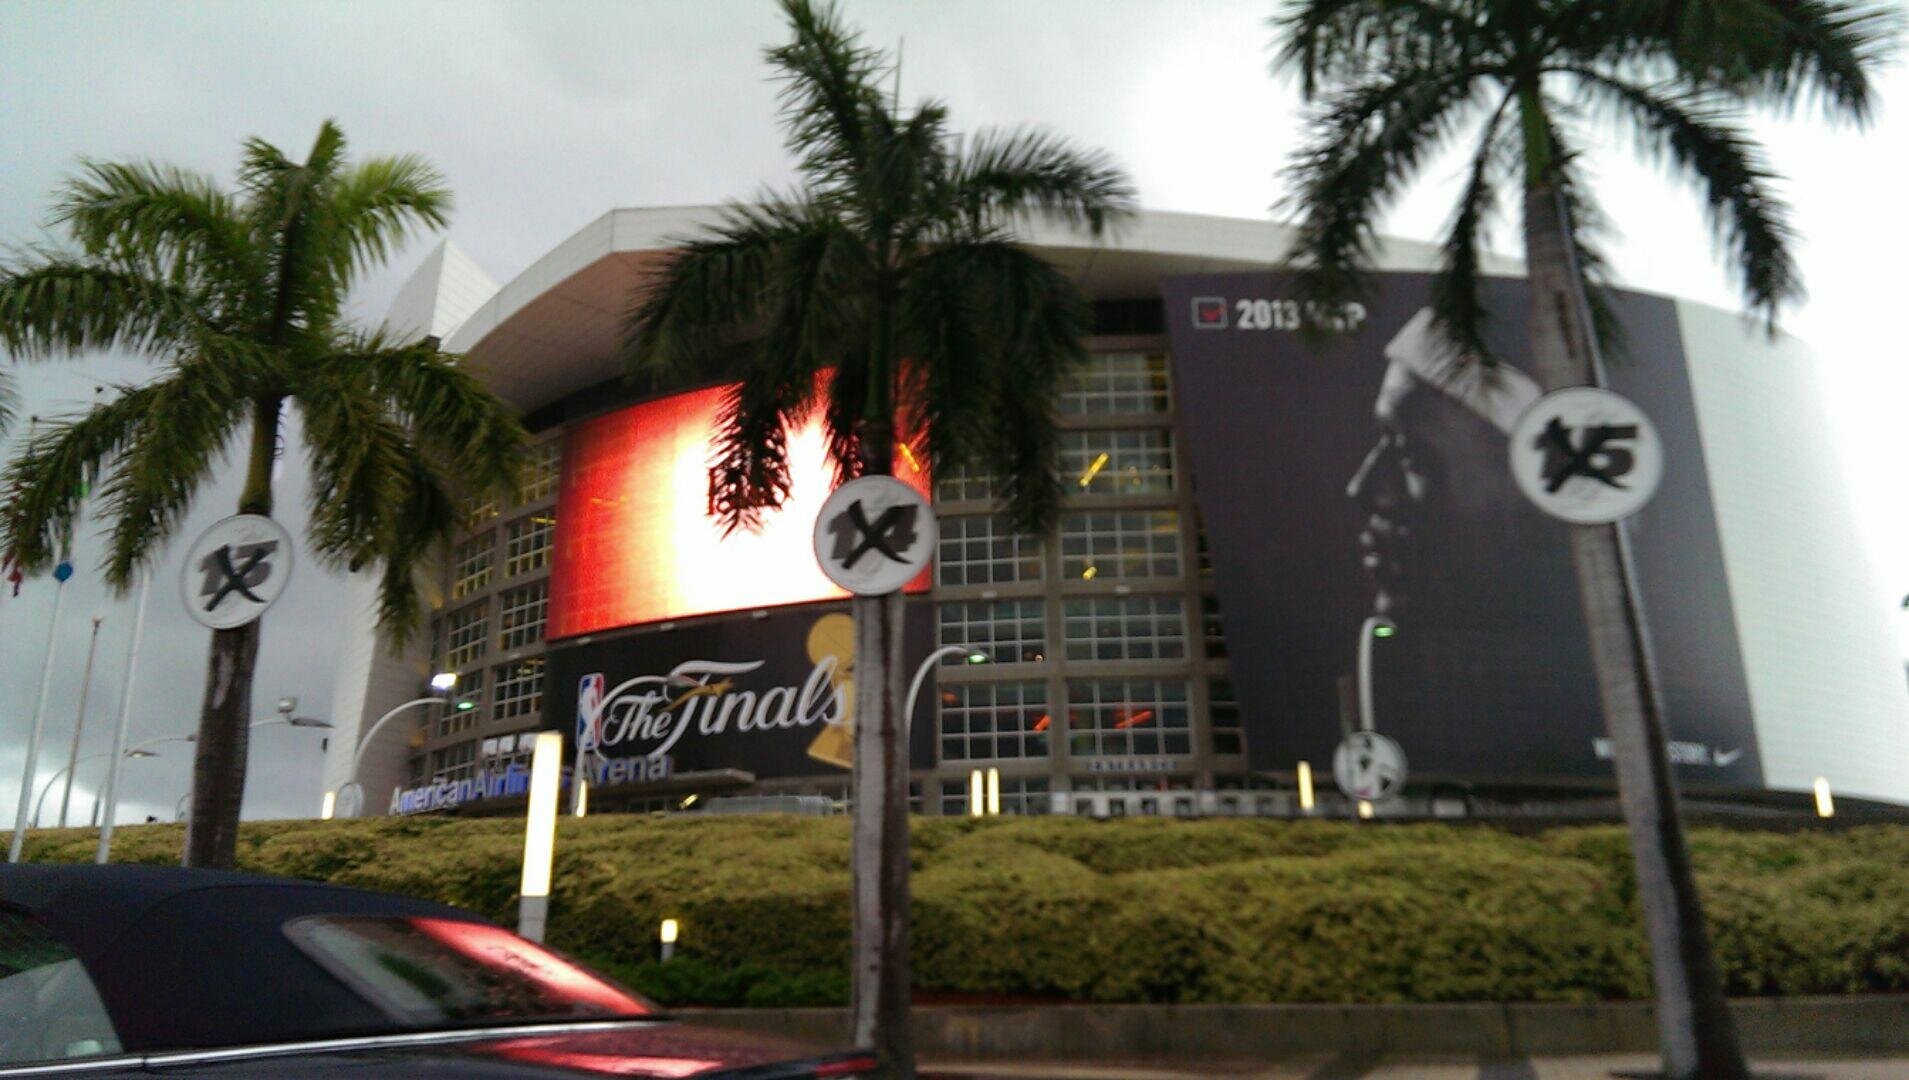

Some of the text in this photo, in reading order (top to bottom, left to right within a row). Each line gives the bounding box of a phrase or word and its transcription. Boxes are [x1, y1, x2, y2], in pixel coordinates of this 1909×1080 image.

[1235, 299, 1299, 330] 2013
[601, 655, 856, 759] The Finals
